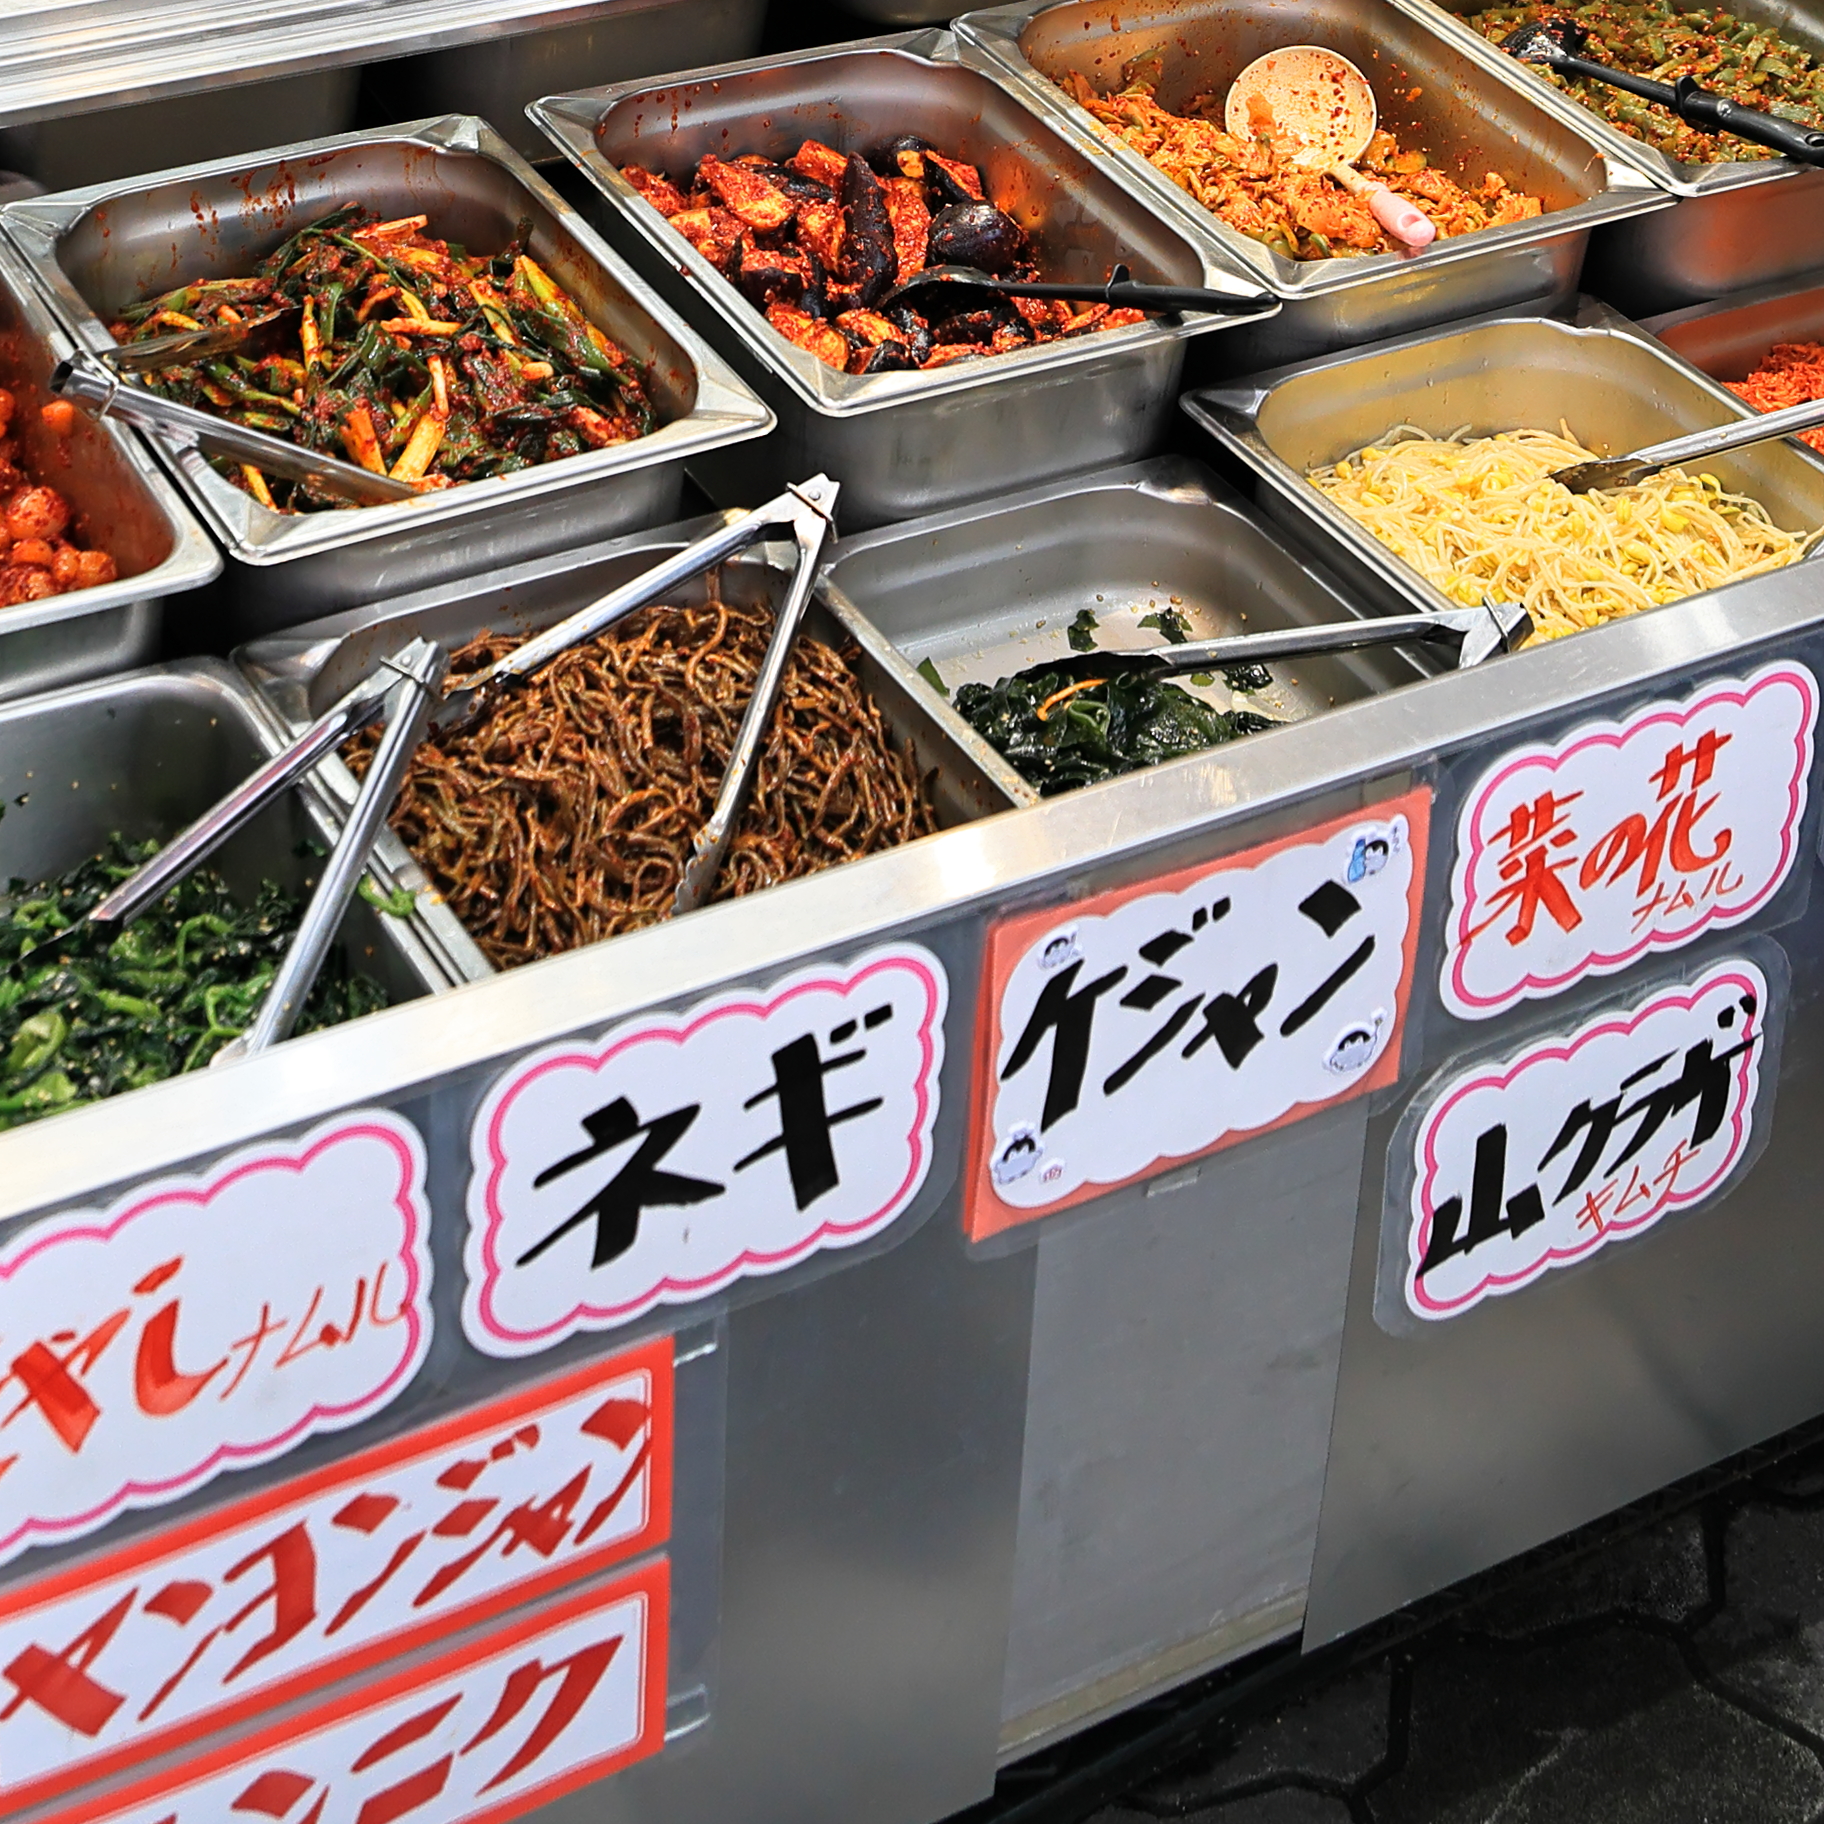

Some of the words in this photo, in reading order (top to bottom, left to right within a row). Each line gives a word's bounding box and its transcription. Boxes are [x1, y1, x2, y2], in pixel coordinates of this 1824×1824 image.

[1453, 727, 1732, 951] 菜の花
[1631, 860, 1744, 934] ナムル
[1001, 880, 1376, 1132] ケジャン
[516, 1002, 894, 1271] ネギ
[1576, 1138, 1701, 1233] キムチ
[221, 1260, 412, 1401] ナムル
